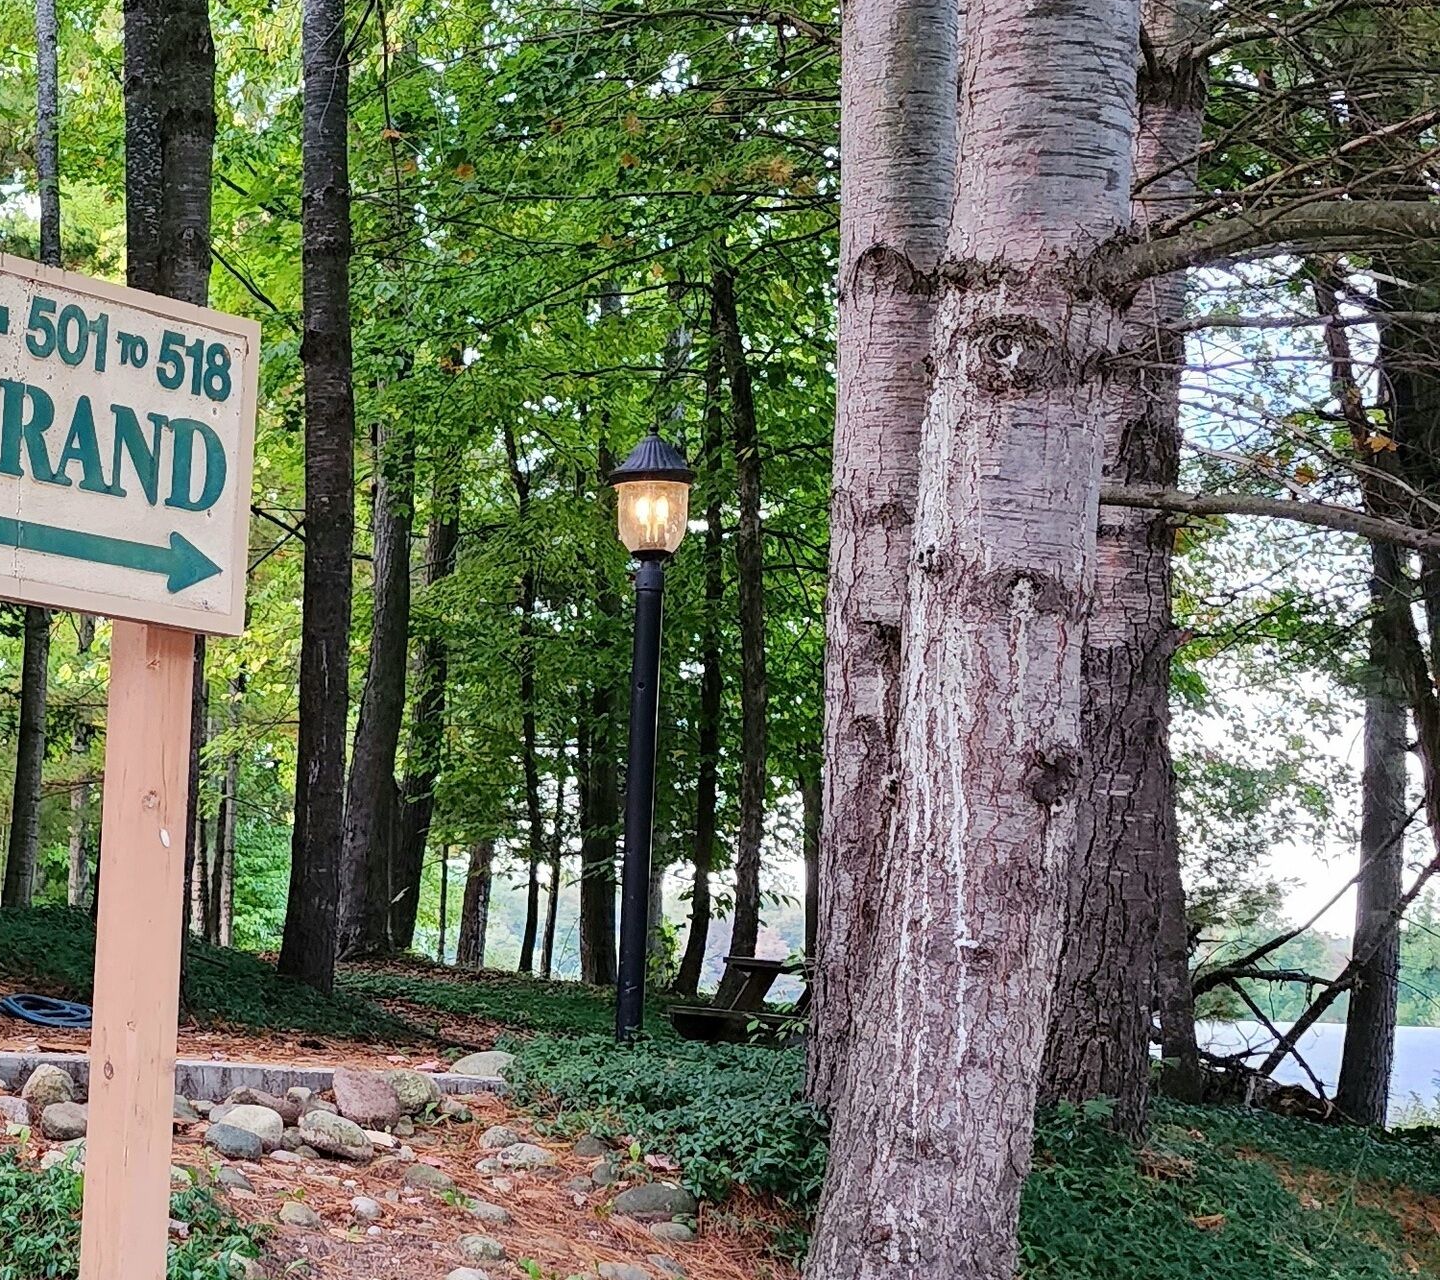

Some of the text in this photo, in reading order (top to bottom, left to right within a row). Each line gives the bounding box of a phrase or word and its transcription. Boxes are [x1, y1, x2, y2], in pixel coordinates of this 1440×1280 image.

[25, 296, 232, 402] 501 TO 518
